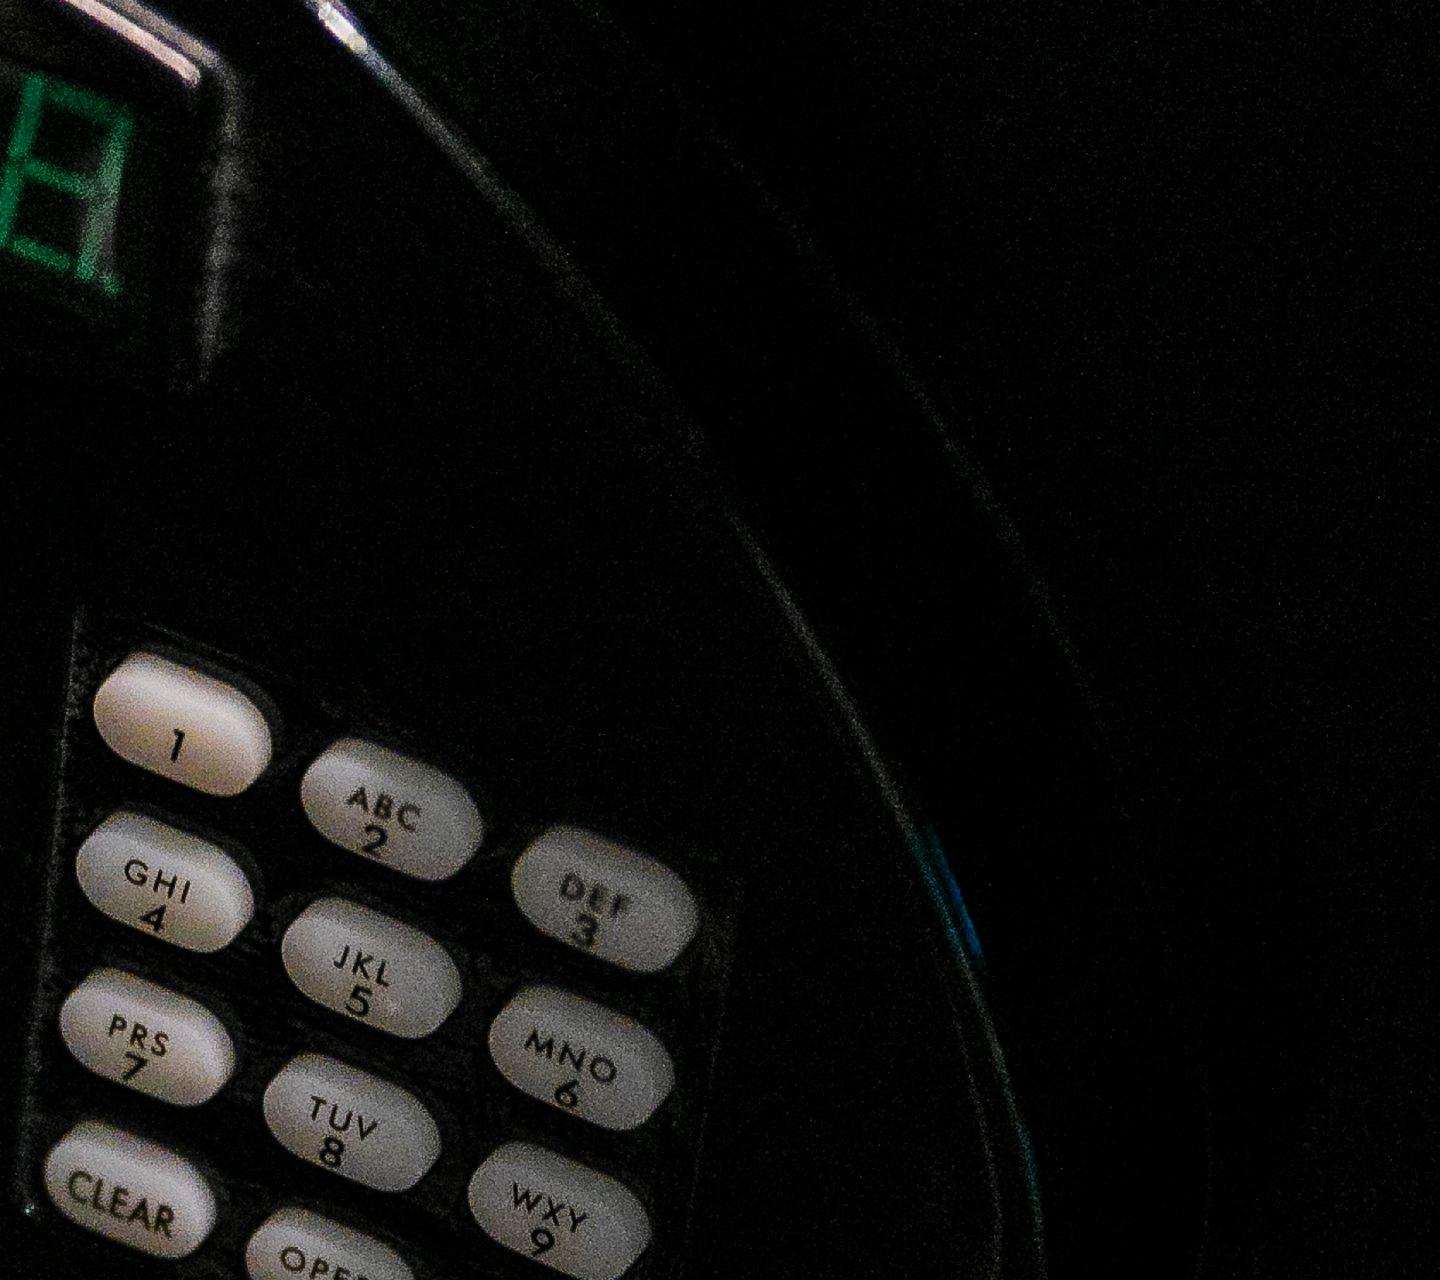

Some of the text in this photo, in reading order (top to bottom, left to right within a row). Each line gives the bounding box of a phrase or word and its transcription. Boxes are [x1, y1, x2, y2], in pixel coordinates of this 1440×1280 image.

[169, 729, 186, 762] 1
[346, 786, 422, 833] ABC
[362, 825, 388, 856] 2
[123, 859, 191, 905] GHI
[139, 905, 165, 933] 4
[333, 945, 391, 987] JKL
[346, 987, 371, 1017] 5
[109, 1014, 169, 1057] PRS
[124, 1054, 148, 1082] 7
[525, 1030, 618, 1084] MNO
[555, 1081, 579, 1110] 6
[309, 1096, 378, 1140] TUV
[321, 1138, 344, 1169] 8
[68, 1170, 175, 1239] CLEAR
[512, 1182, 587, 1234] WXY
[531, 1227, 556, 1258] 9
